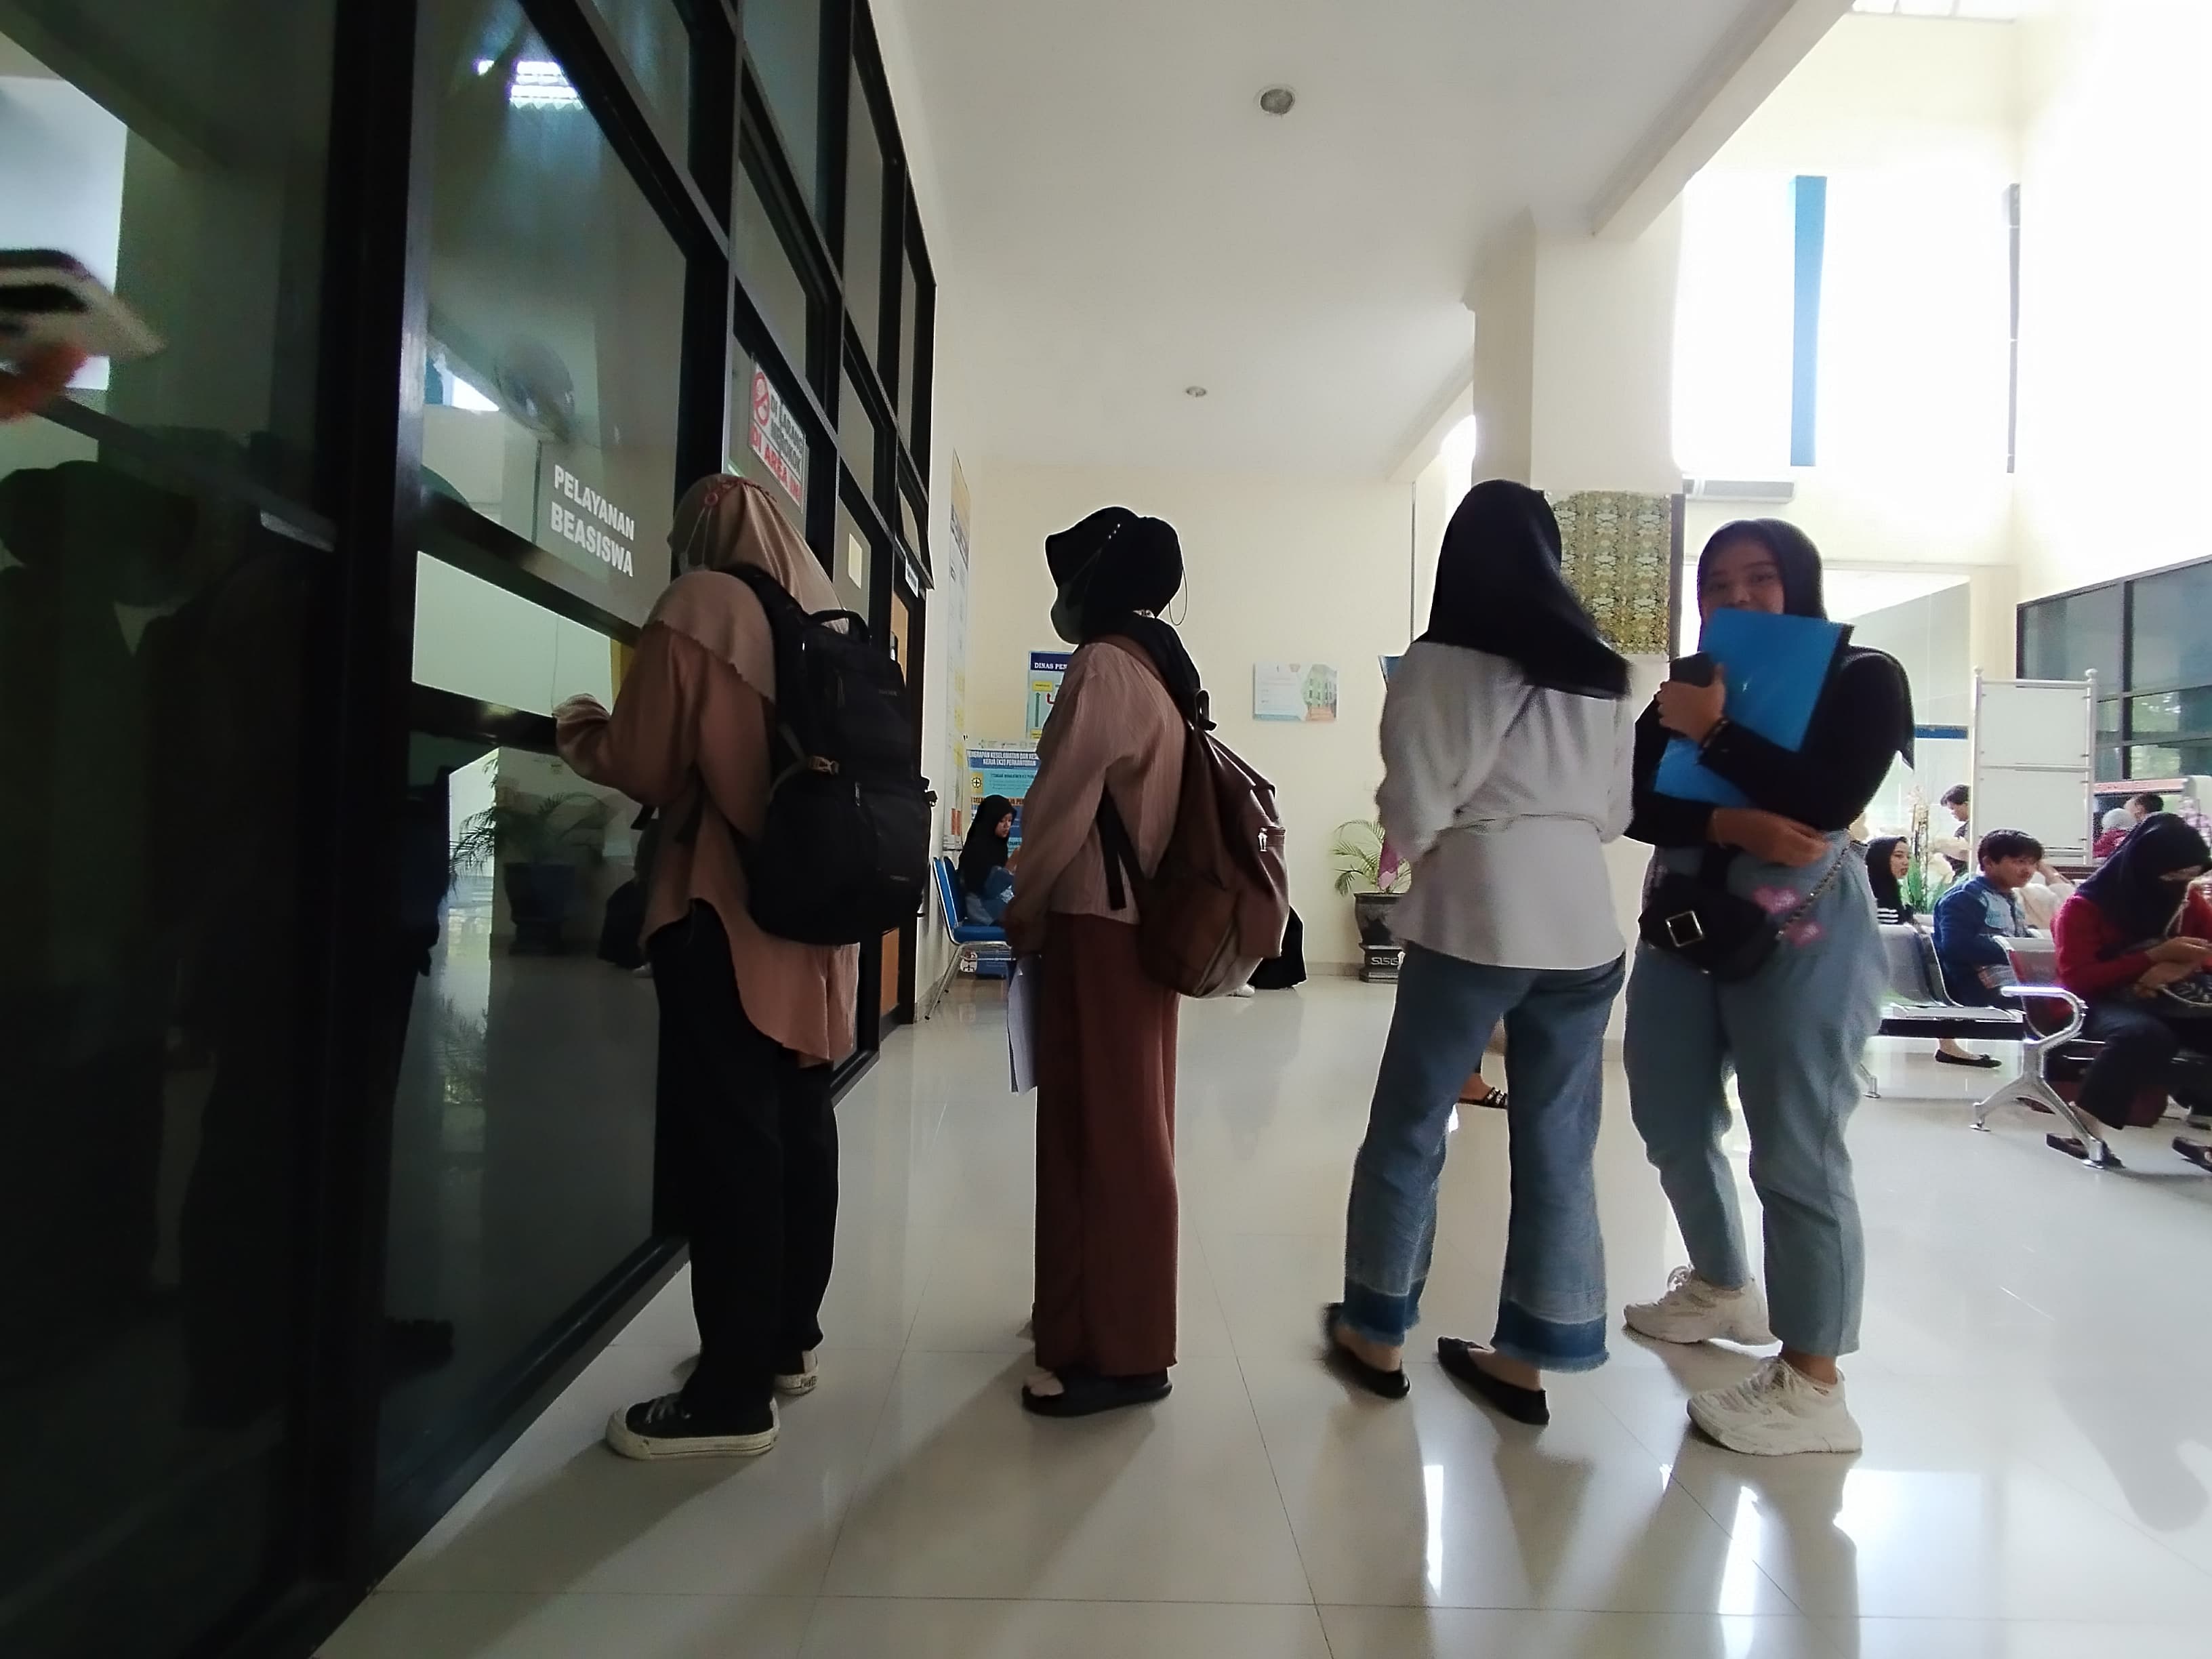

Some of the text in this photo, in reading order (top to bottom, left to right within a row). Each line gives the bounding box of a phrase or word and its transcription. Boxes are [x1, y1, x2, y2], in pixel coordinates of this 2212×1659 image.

[750, 423, 762, 452] DI
[764, 446, 788, 484] AREA
[551, 501, 634, 577] BEASISWA
[554, 464, 634, 541] PELAYANAN
